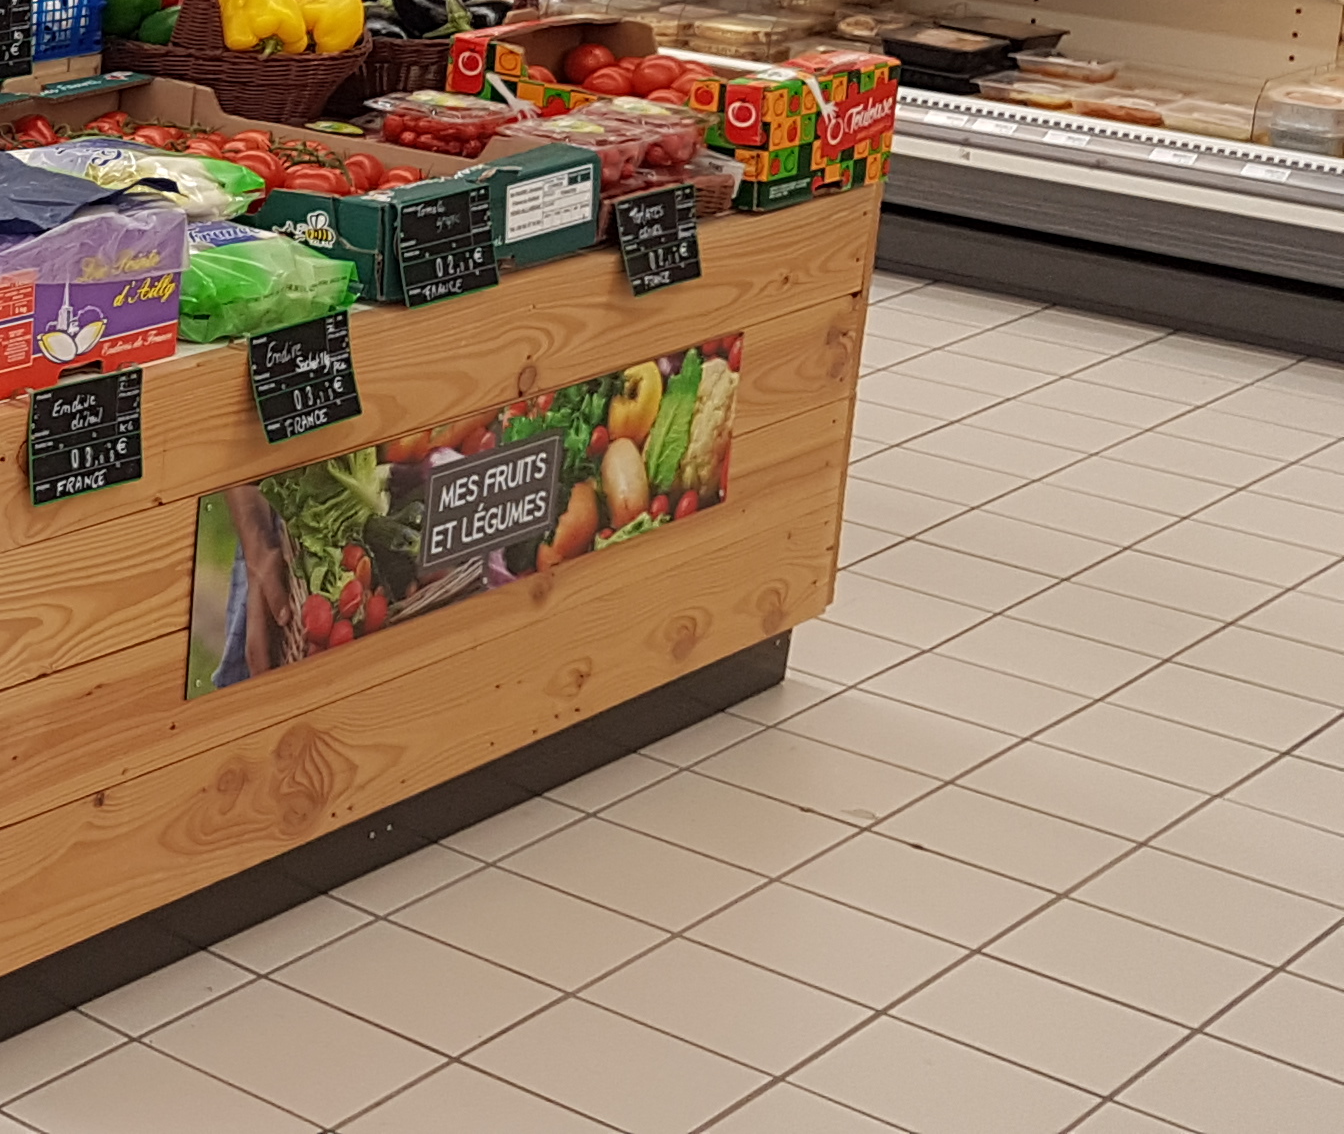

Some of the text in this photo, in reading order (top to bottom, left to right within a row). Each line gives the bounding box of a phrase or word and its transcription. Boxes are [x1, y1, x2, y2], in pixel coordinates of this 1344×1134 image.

[113, 274, 177, 307] d'Ailly
[101, 330, 173, 357] Endives de France
[284, 408, 328, 438] FRANCE
[56, 468, 108, 497] FRANCE
[438, 452, 547, 513] MES FRUITS
[430, 490, 547, 555] ET LÉGUMES
